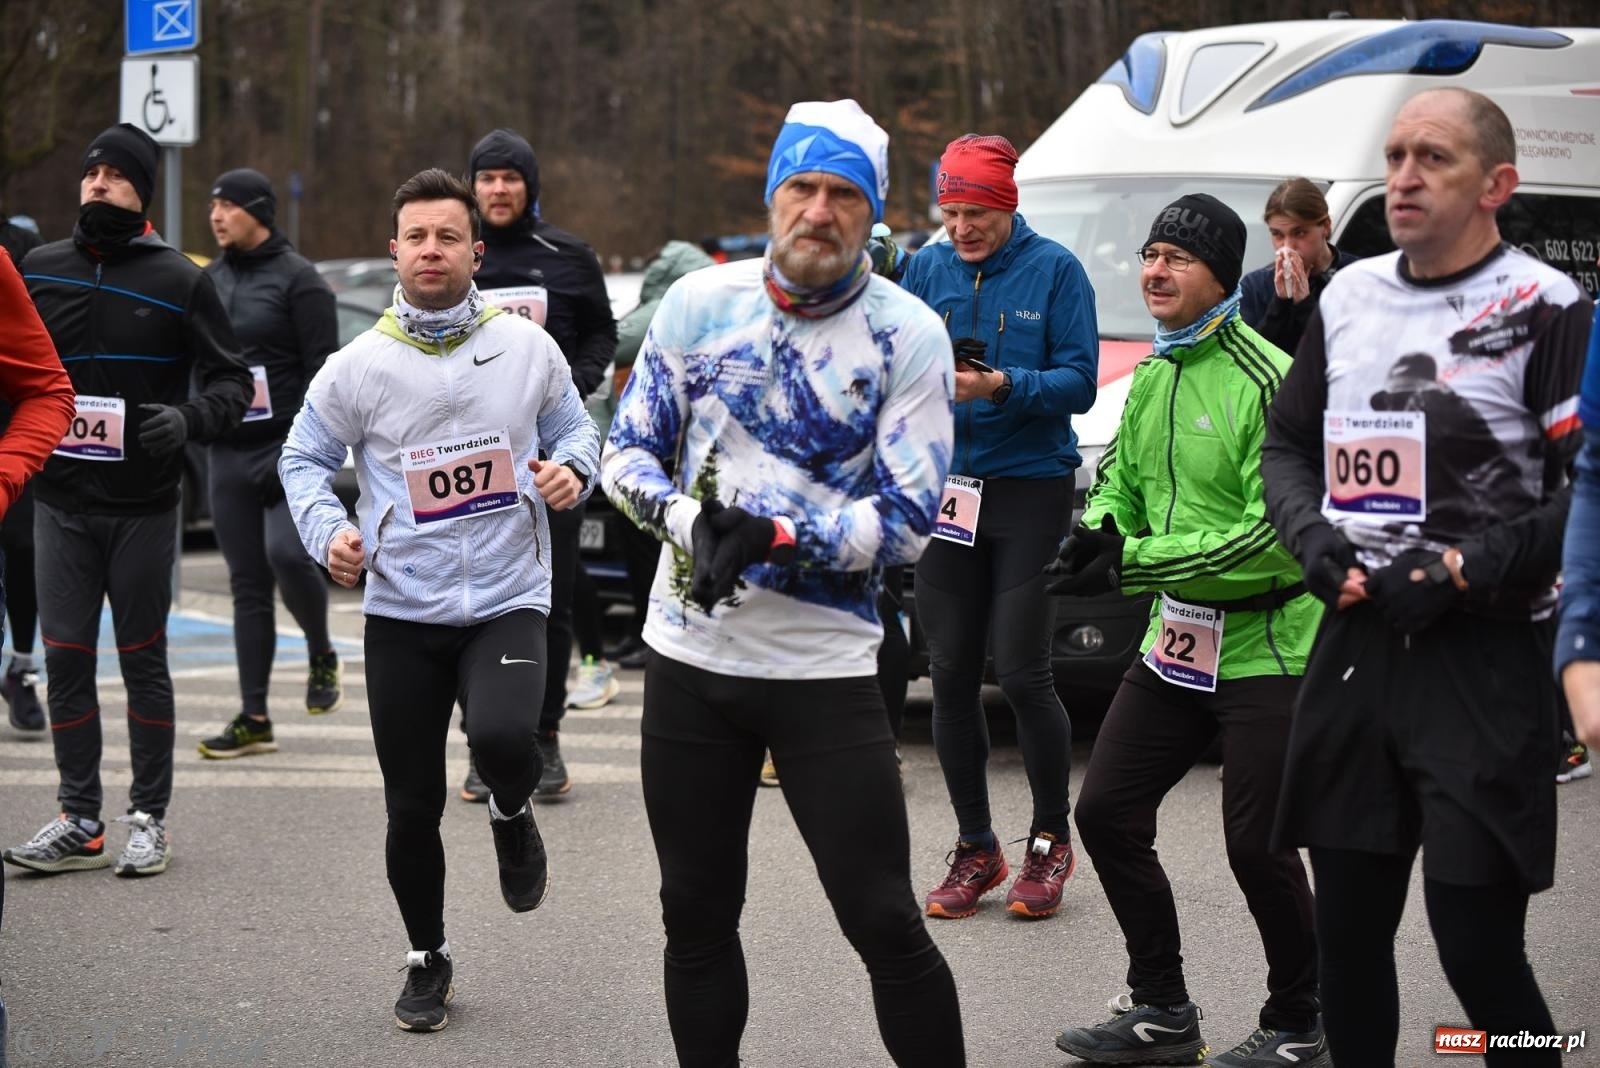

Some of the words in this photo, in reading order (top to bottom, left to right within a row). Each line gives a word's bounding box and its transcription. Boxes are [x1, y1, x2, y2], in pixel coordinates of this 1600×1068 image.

[1545, 239, 1570, 261] 602
[1571, 240, 1595, 261] 622
[1023, 310, 1041, 320] Rab
[1345, 417, 1414, 430] Twardziela
[410, 448, 435, 461] BIEG
[436, 435, 501, 455] Twardziela
[428, 459, 493, 499] 087
[1336, 448, 1400, 487] 060
